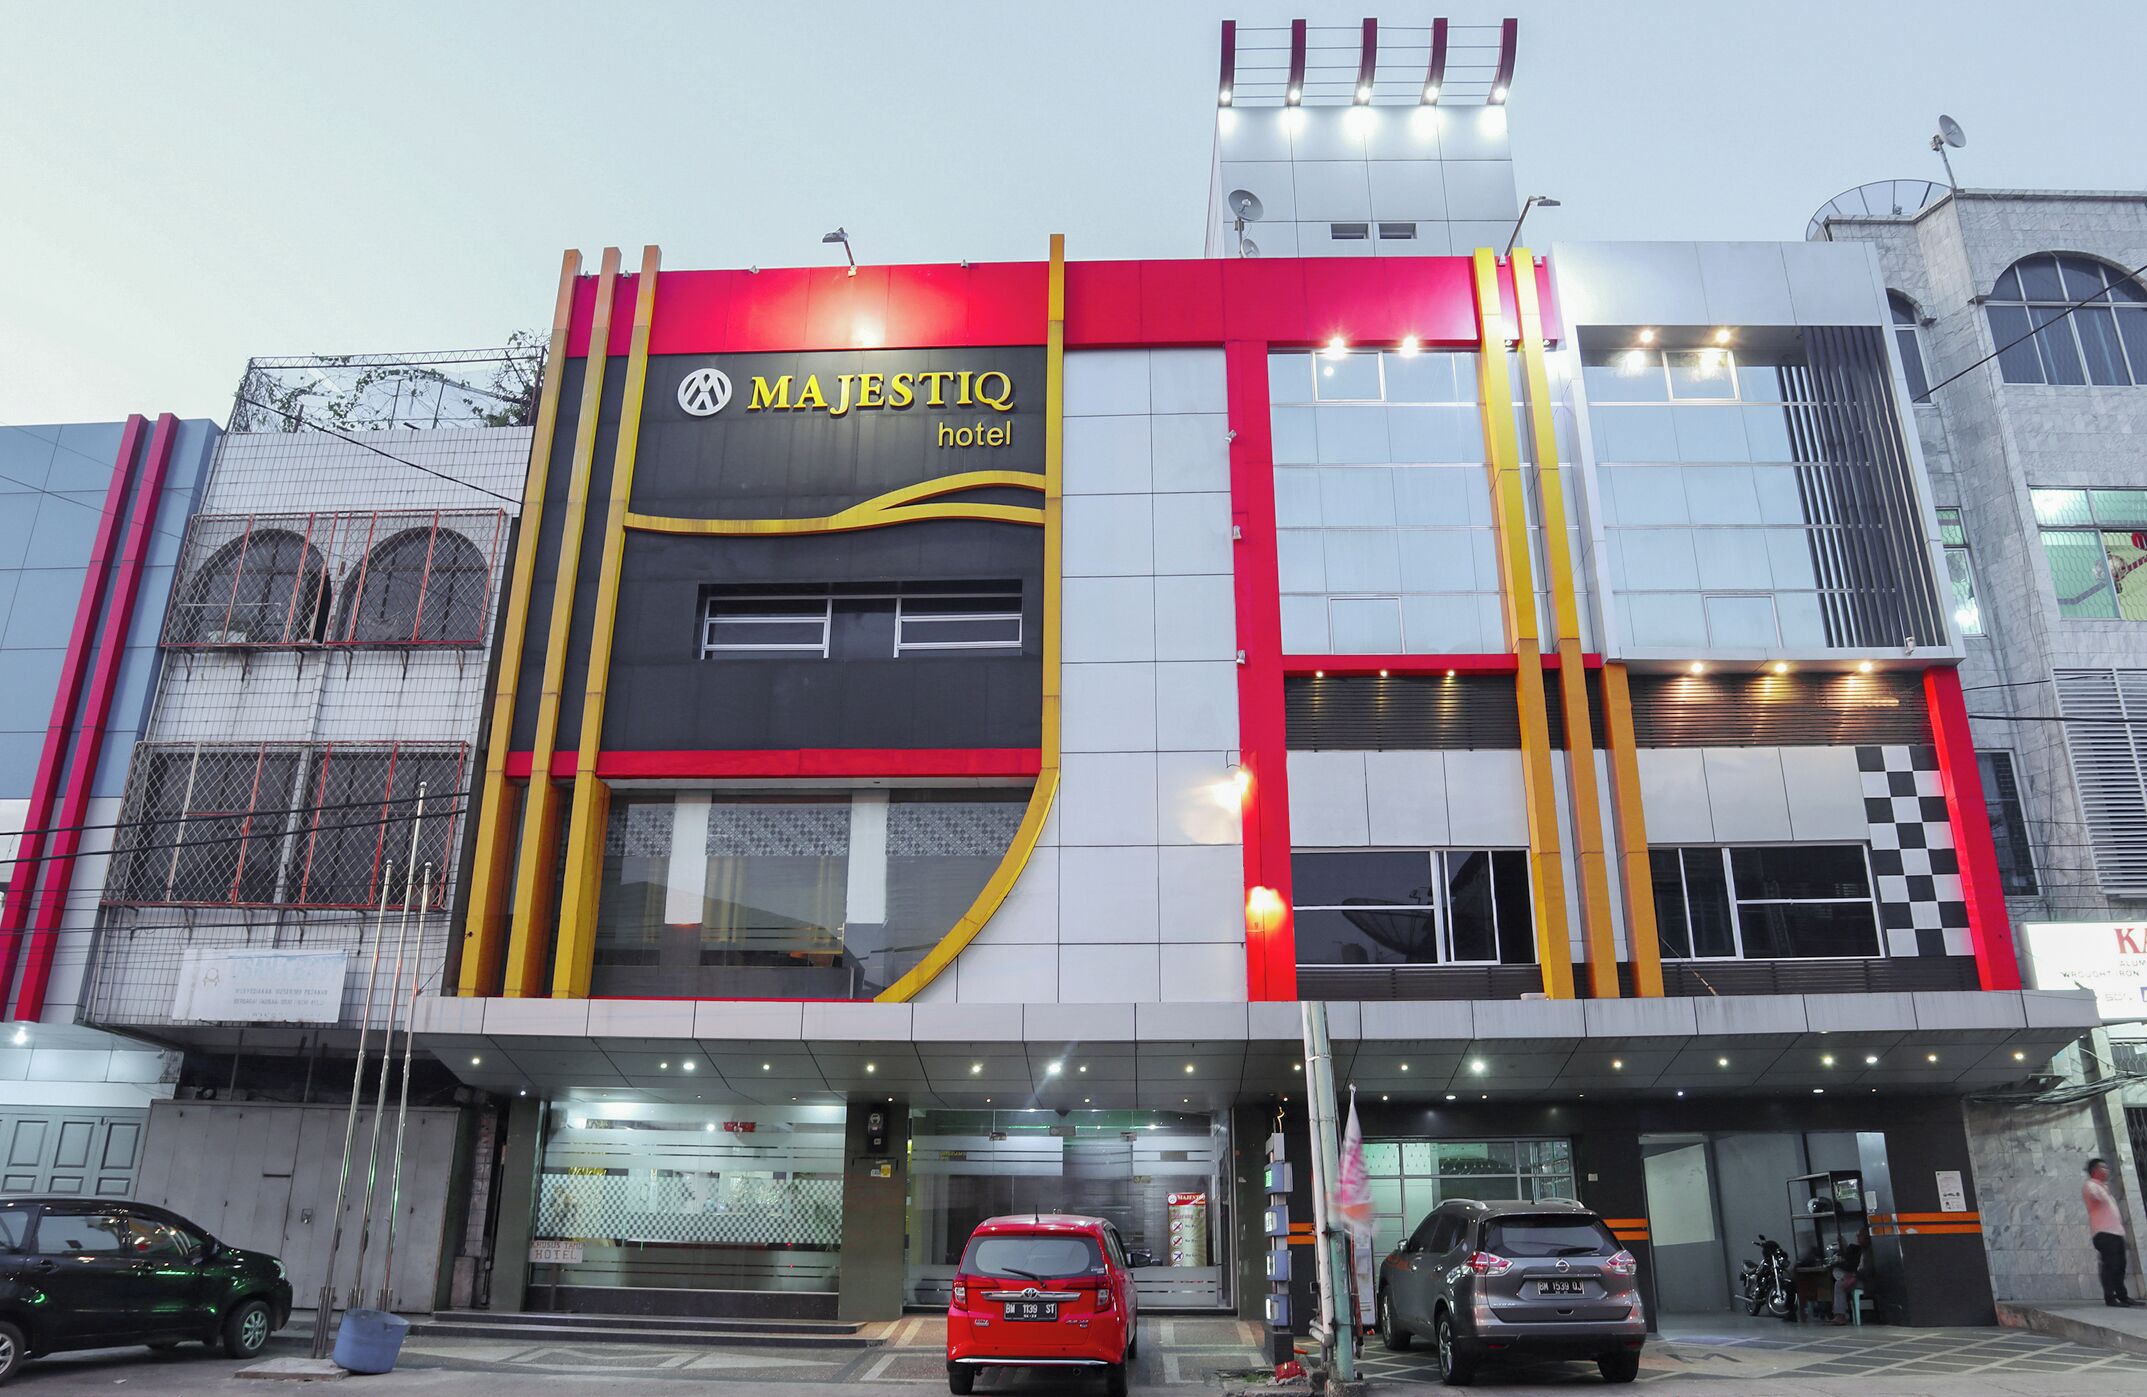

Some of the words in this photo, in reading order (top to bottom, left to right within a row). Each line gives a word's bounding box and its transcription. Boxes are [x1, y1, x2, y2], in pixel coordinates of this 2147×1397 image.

[747, 371, 1014, 416] MAJESTIQ
[938, 420, 1012, 447] hotel
[2116, 969, 2140, 977] IRON
[535, 1249, 577, 1260] HOTEL
[1539, 1281, 1549, 1291] BM
[1552, 1281, 1569, 1291] 1539
[1005, 1303, 1015, 1314] BM
[1023, 1303, 1038, 1314] 1139
[1045, 1303, 1056, 1314] ST
